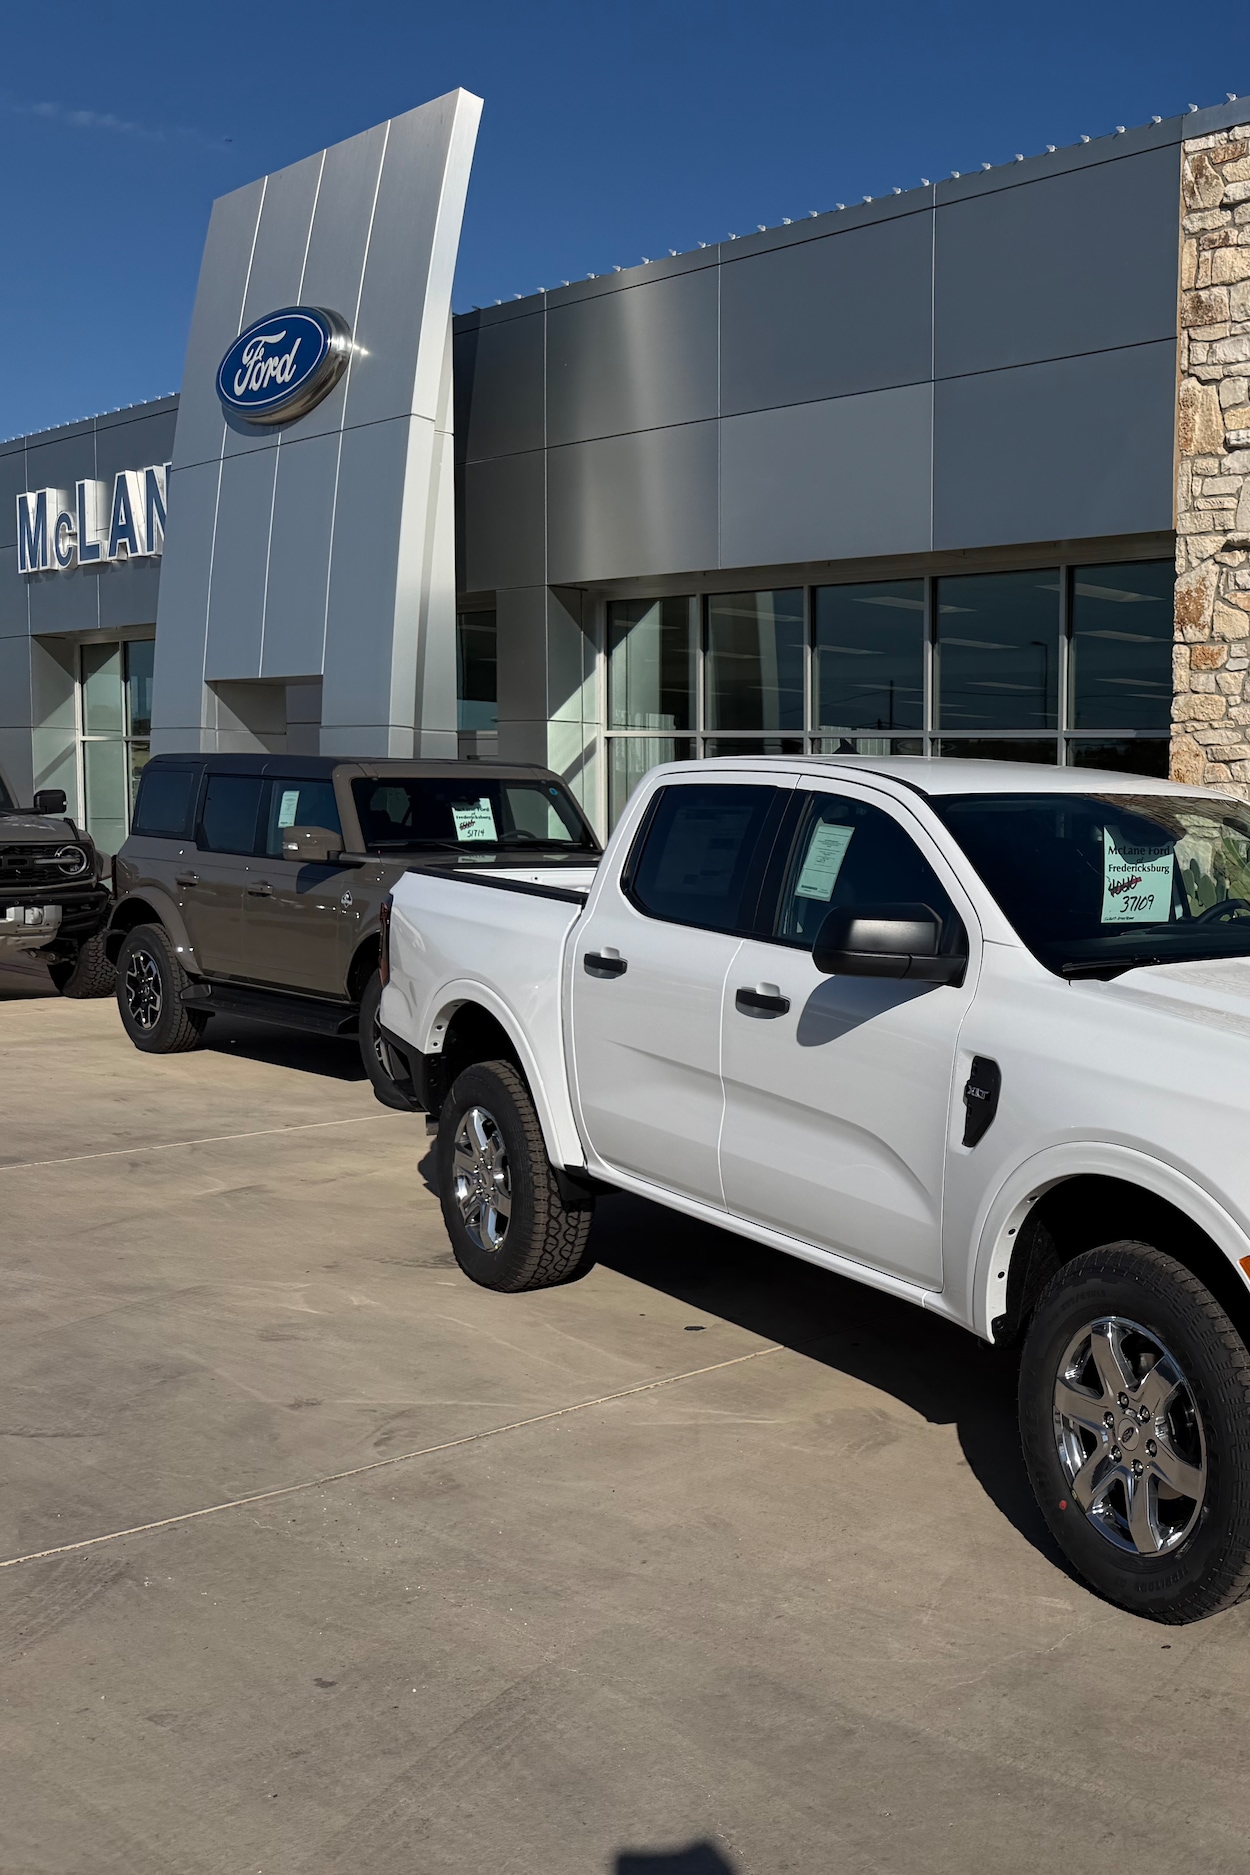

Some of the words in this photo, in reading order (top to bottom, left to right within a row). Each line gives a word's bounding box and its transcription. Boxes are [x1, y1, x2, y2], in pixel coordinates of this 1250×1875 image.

[233, 330, 302, 396] Ford
[1108, 846, 1146, 856] McLane
[1148, 846, 1170, 856] Ford
[1108, 864, 1170, 874] Fredericksburg
[1120, 894, 1154, 912] 37109
